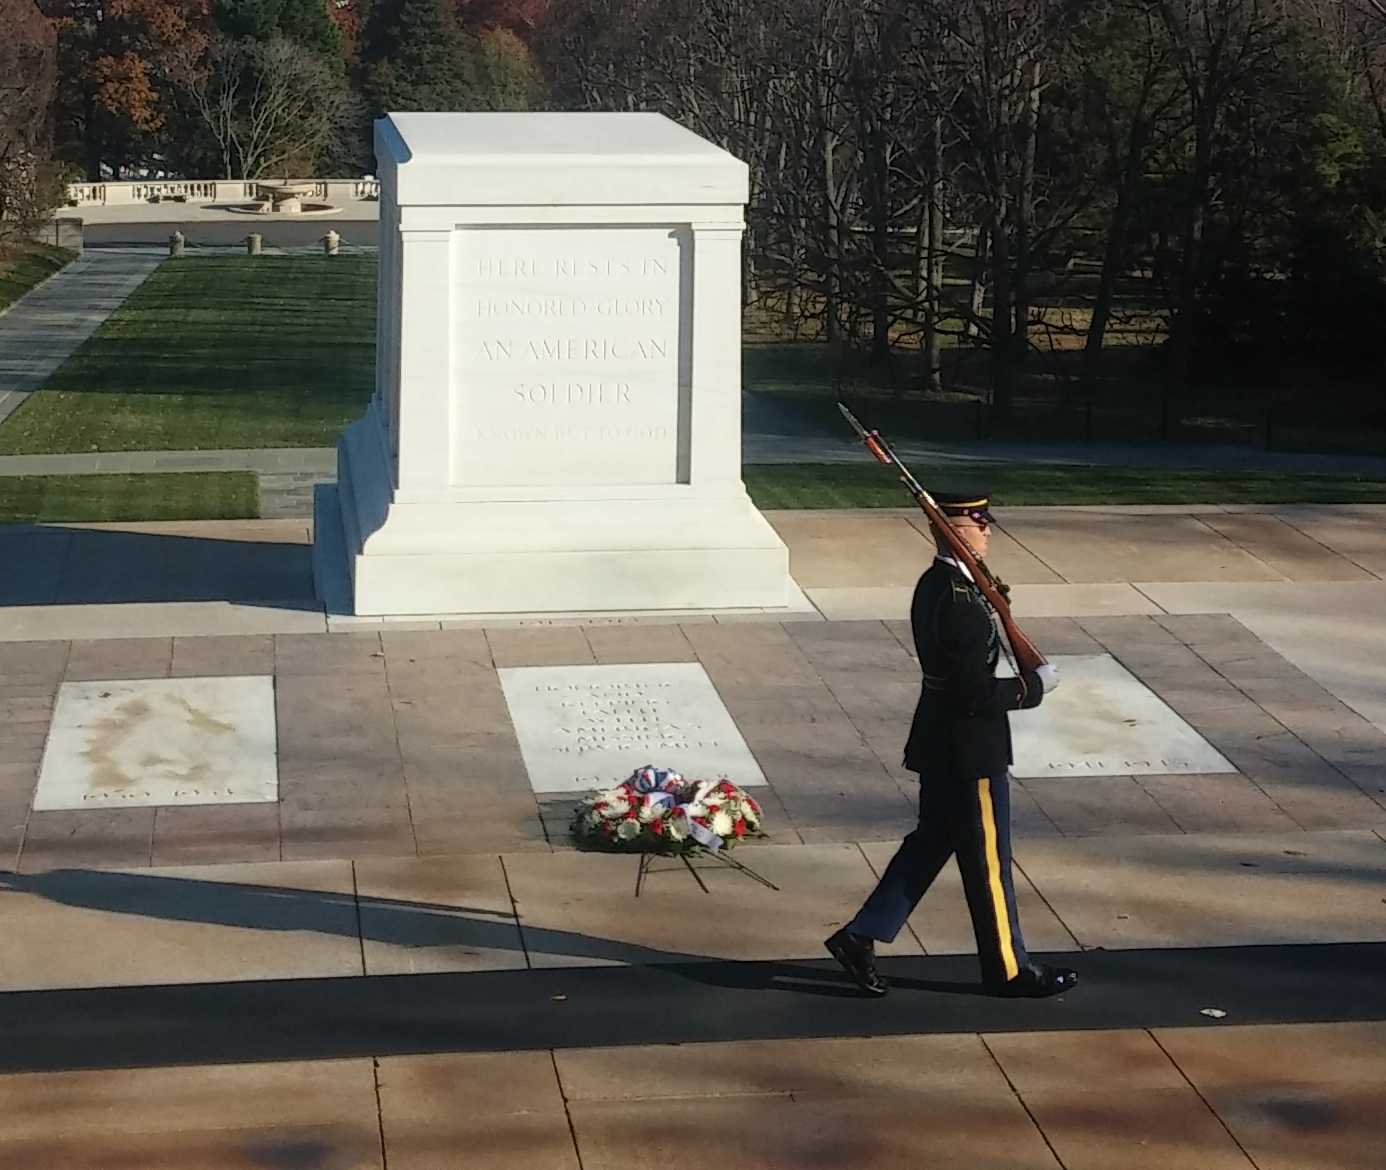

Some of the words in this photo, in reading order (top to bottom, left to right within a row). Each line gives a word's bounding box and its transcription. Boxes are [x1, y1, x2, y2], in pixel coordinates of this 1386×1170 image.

[477, 258, 542, 277] HERE
[554, 258, 630, 276] RESTS
[641, 258, 668, 276] IN
[476, 299, 586, 317] HONORED
[596, 298, 669, 317] GLORY
[475, 339, 513, 361] AN
[521, 338, 667, 360] AMERICAN
[512, 382, 632, 404] SOLDIER
[477, 426, 547, 443] KNOWN
[626, 425, 668, 441] GOD
